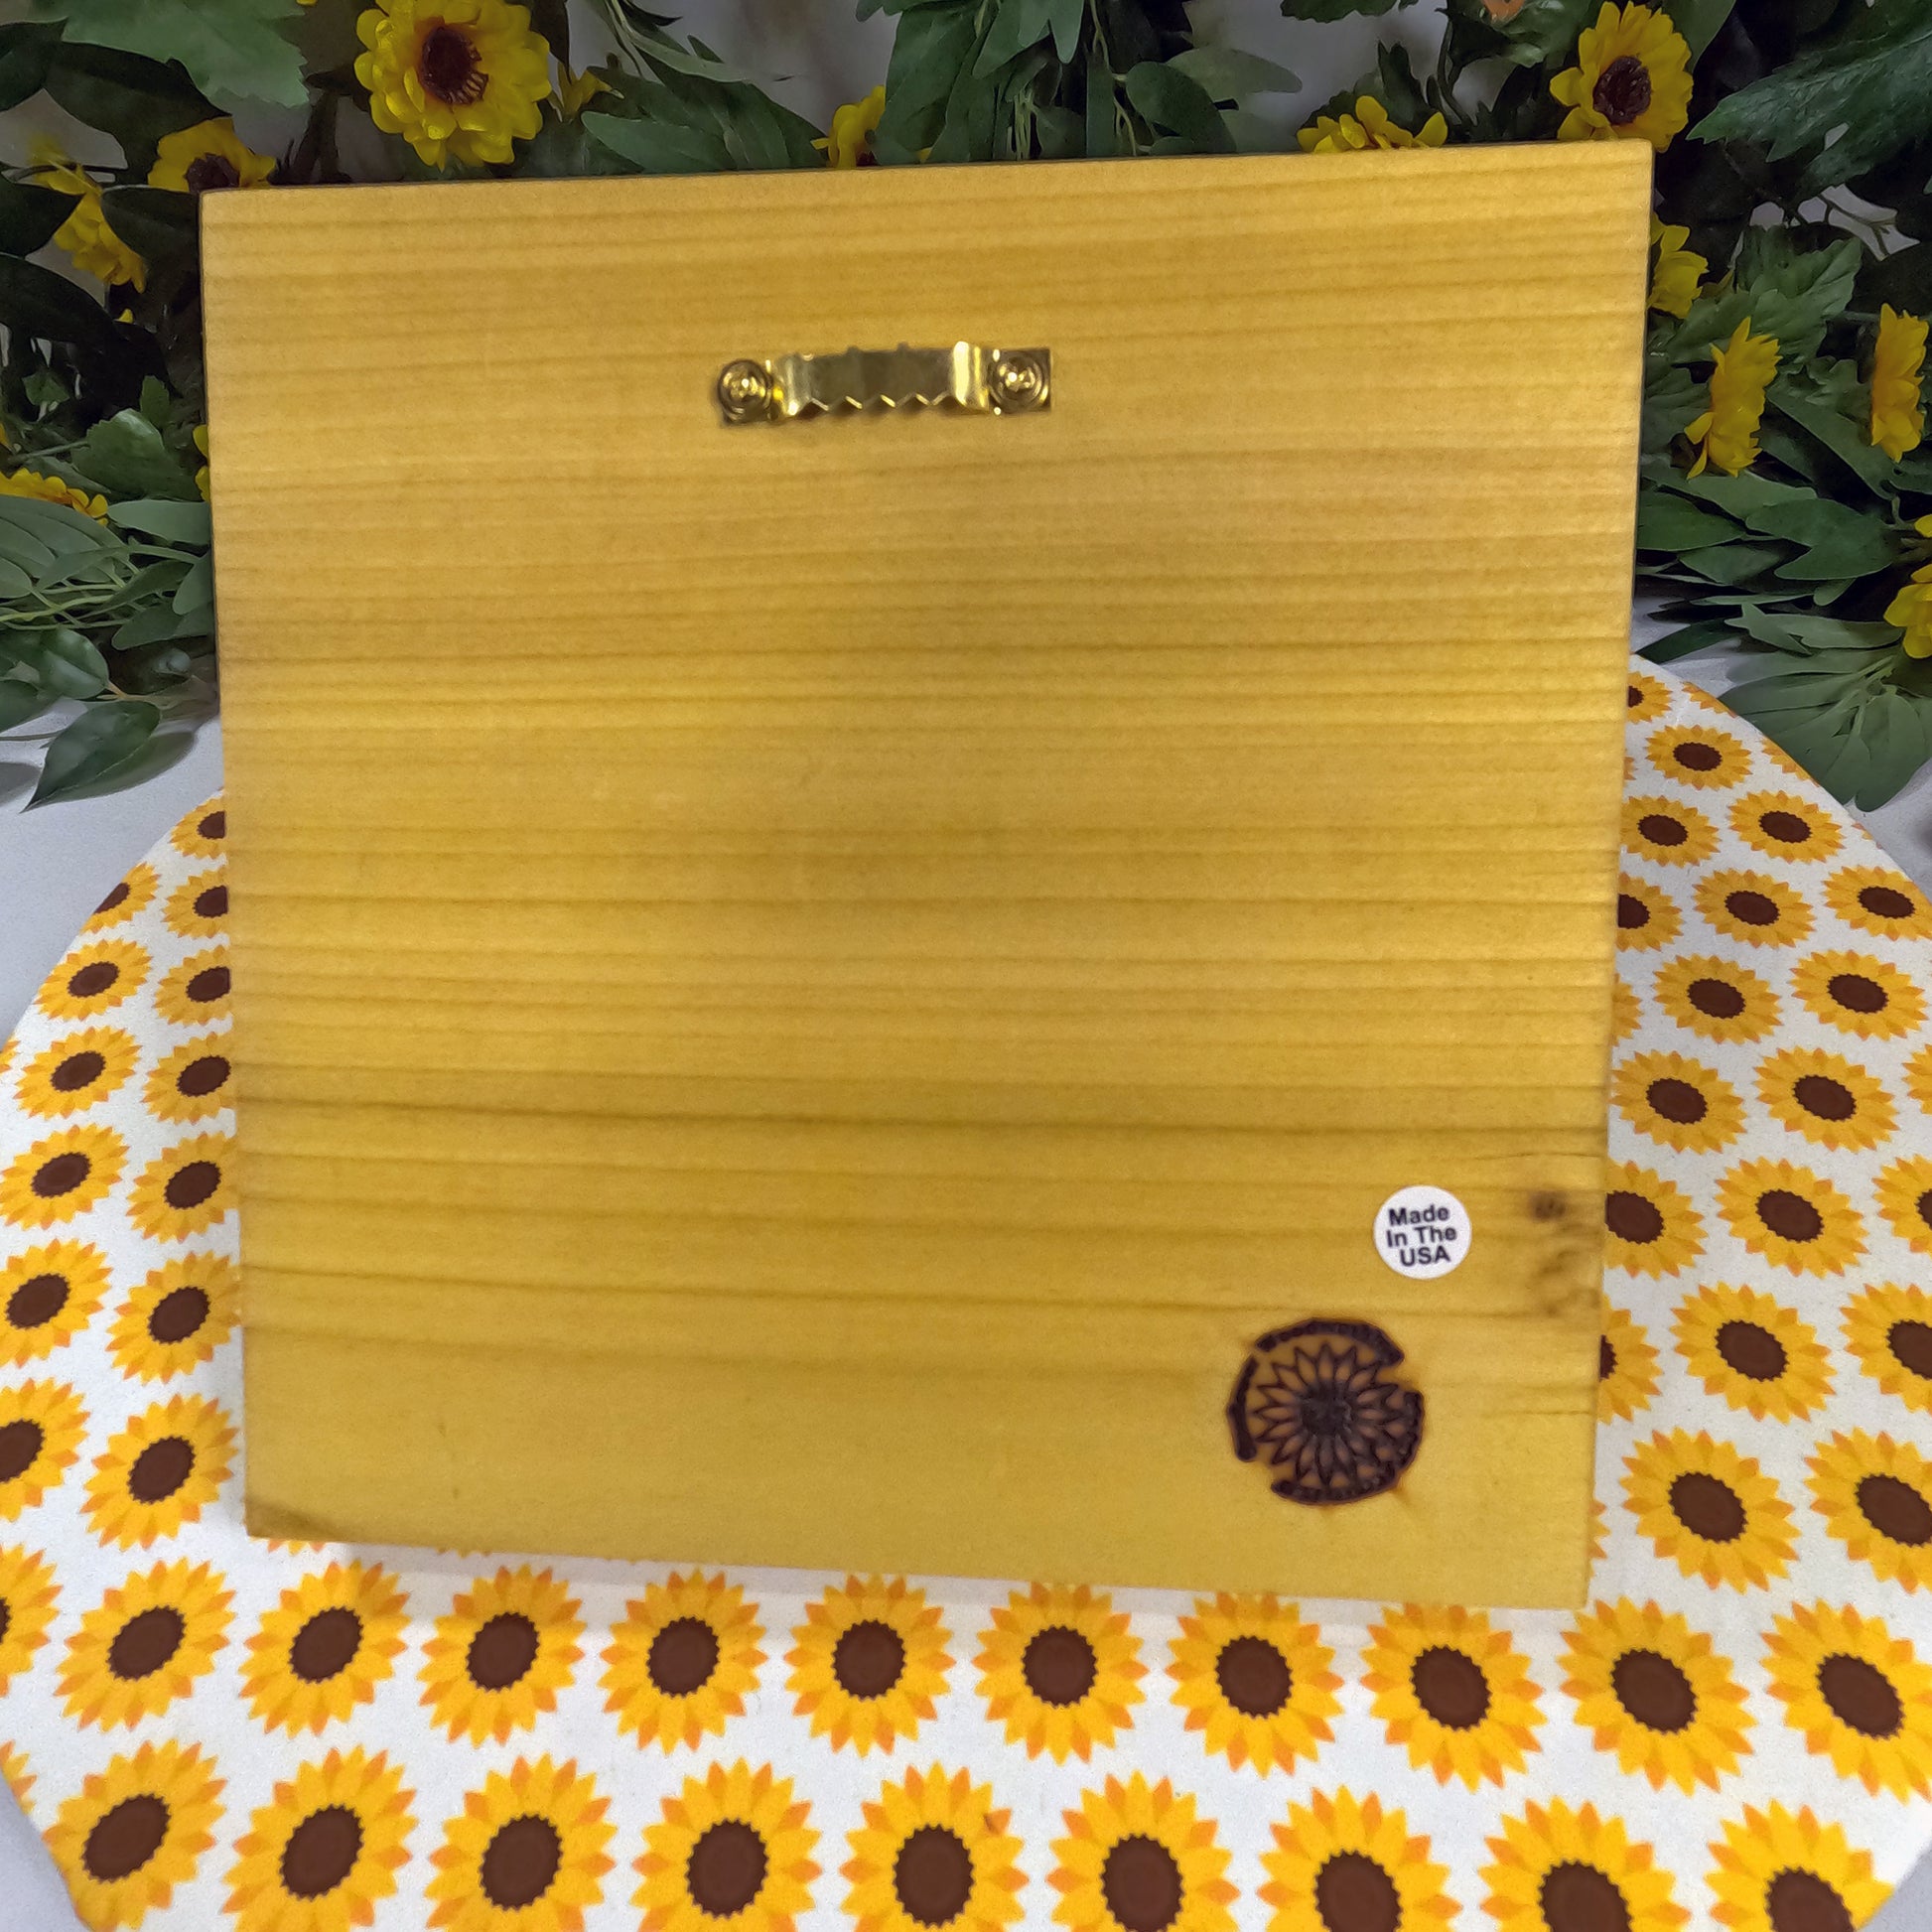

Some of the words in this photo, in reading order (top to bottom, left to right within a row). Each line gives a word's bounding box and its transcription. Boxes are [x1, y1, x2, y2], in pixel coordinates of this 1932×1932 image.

[1389, 1203, 1449, 1226] Made
[1386, 1229, 1408, 1248] In
[1414, 1226, 1456, 1244] The
[1400, 1245, 1451, 1267] USA
